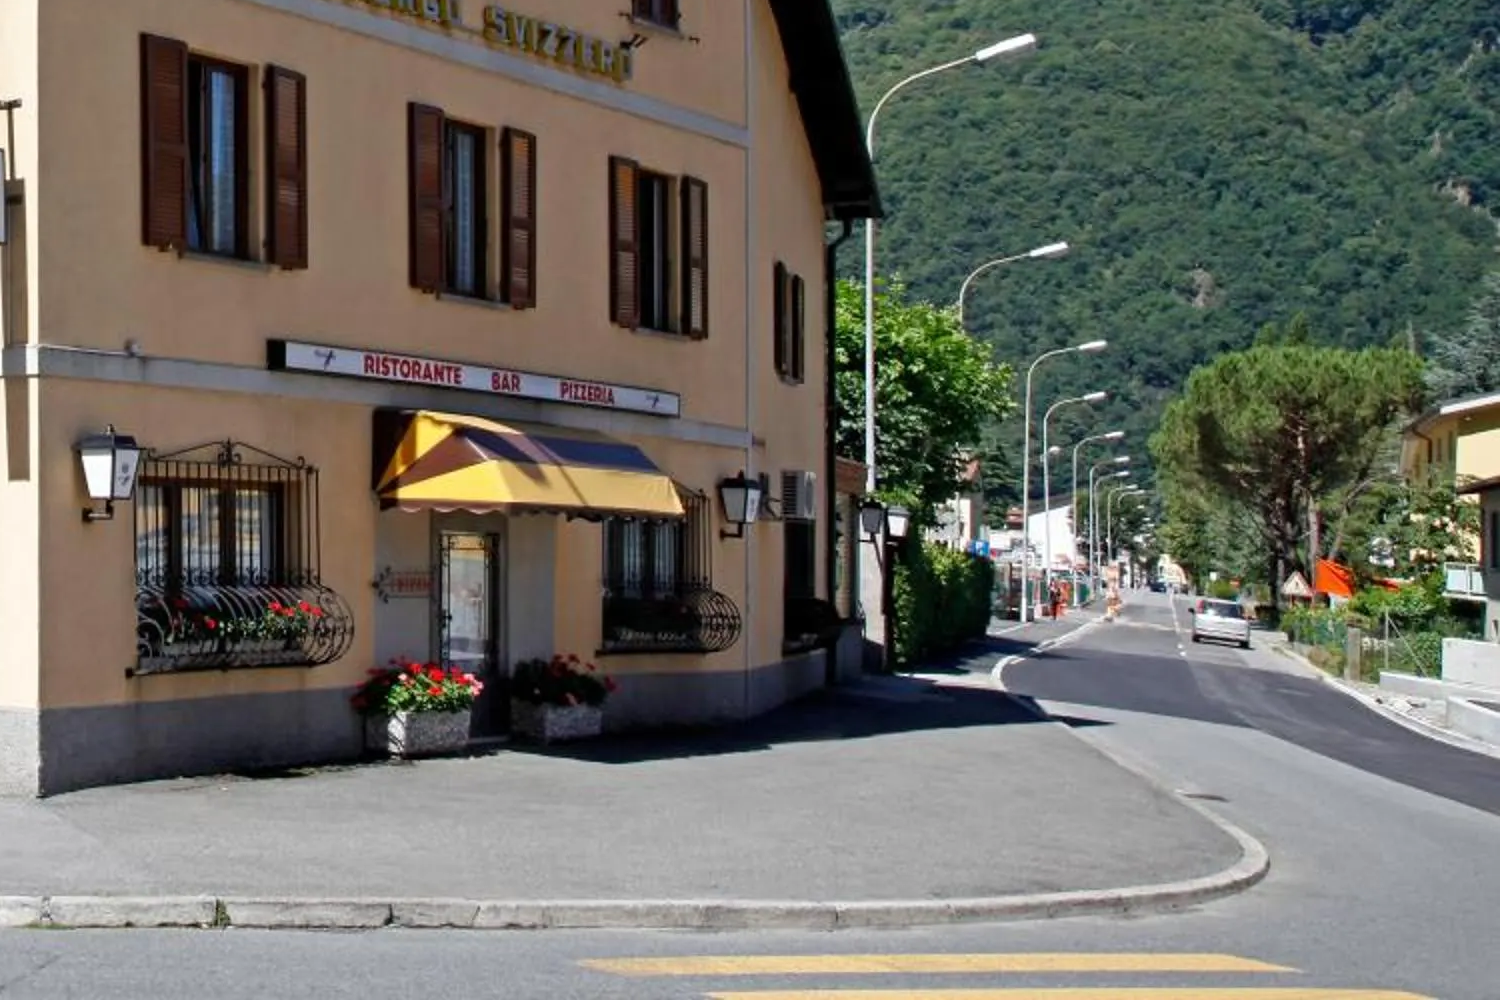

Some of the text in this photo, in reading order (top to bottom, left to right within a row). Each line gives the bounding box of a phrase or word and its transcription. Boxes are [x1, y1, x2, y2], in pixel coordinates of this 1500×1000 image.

[484, 4, 633, 81] SVIZZERO
[363, 355, 616, 405] RISTORANTE BAR PIZZERIA
